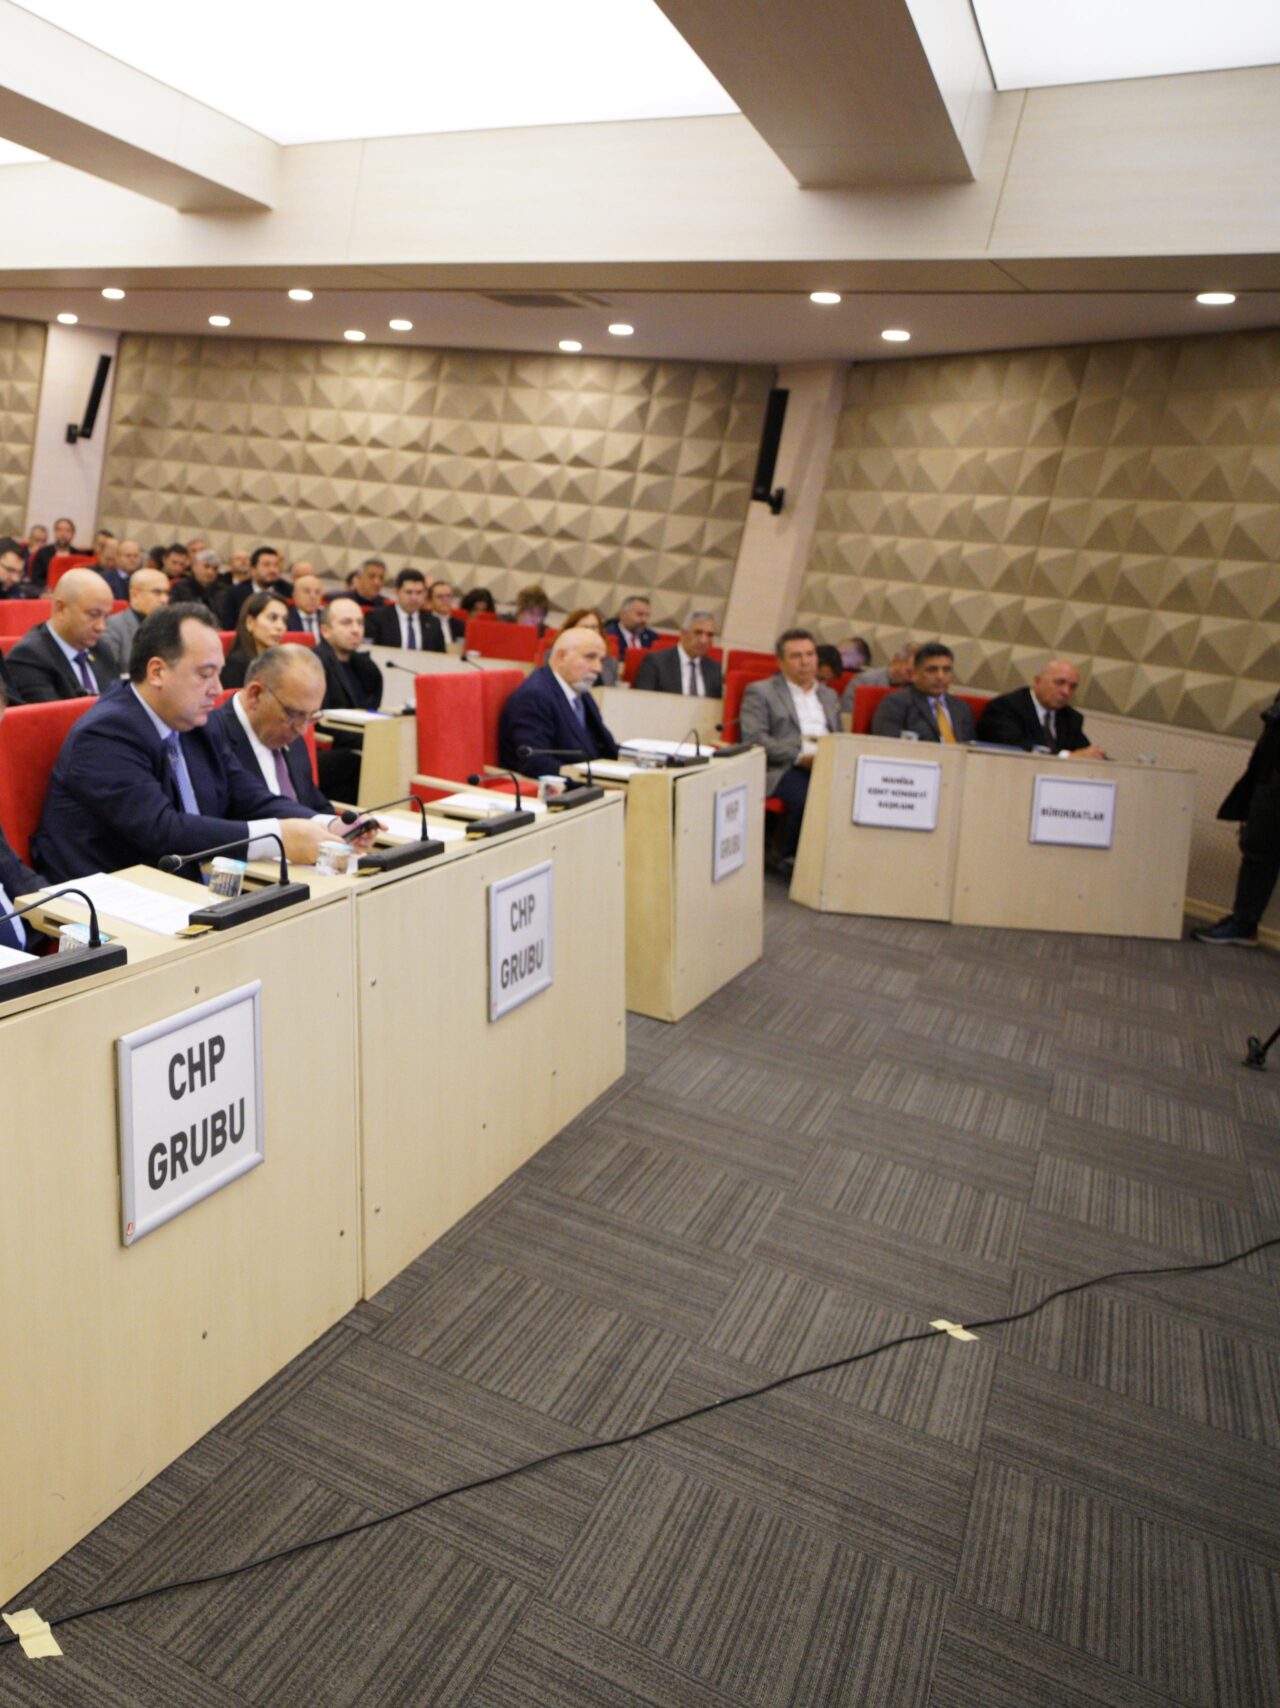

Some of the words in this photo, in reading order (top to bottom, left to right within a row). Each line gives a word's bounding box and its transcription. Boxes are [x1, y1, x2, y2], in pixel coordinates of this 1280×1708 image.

[1041, 806, 1104, 821] BÜROKRATLAR
[510, 894, 536, 932] CHP
[501, 939, 544, 989] GRUBU
[169, 1034, 226, 1101] CHP
[147, 1097, 245, 1190] GRUBU
